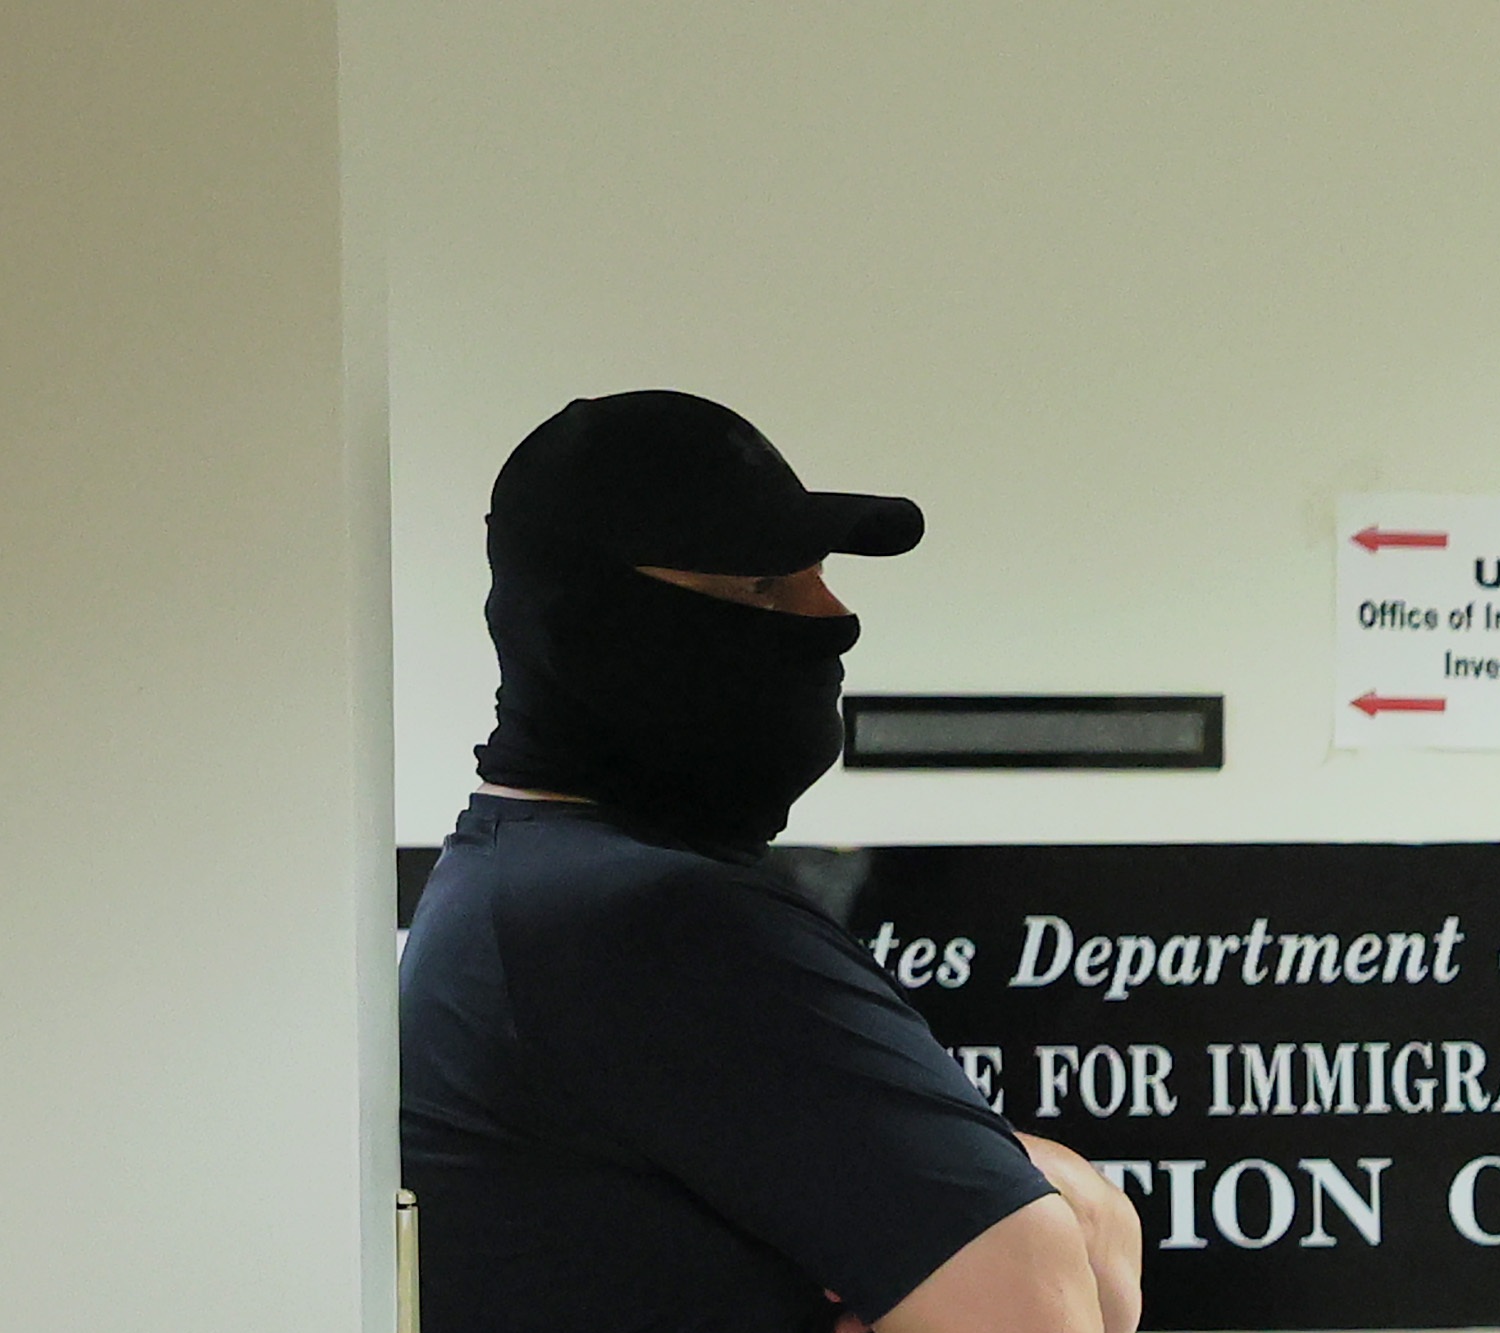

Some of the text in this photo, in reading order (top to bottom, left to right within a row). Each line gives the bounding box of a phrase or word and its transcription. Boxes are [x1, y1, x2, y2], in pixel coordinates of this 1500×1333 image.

[1359, 600, 1438, 629] Office
[1449, 603, 1473, 630] of
[869, 922, 976, 988] tes
[1008, 915, 1465, 1000] Department
[1035, 1044, 1178, 1117] FOR
